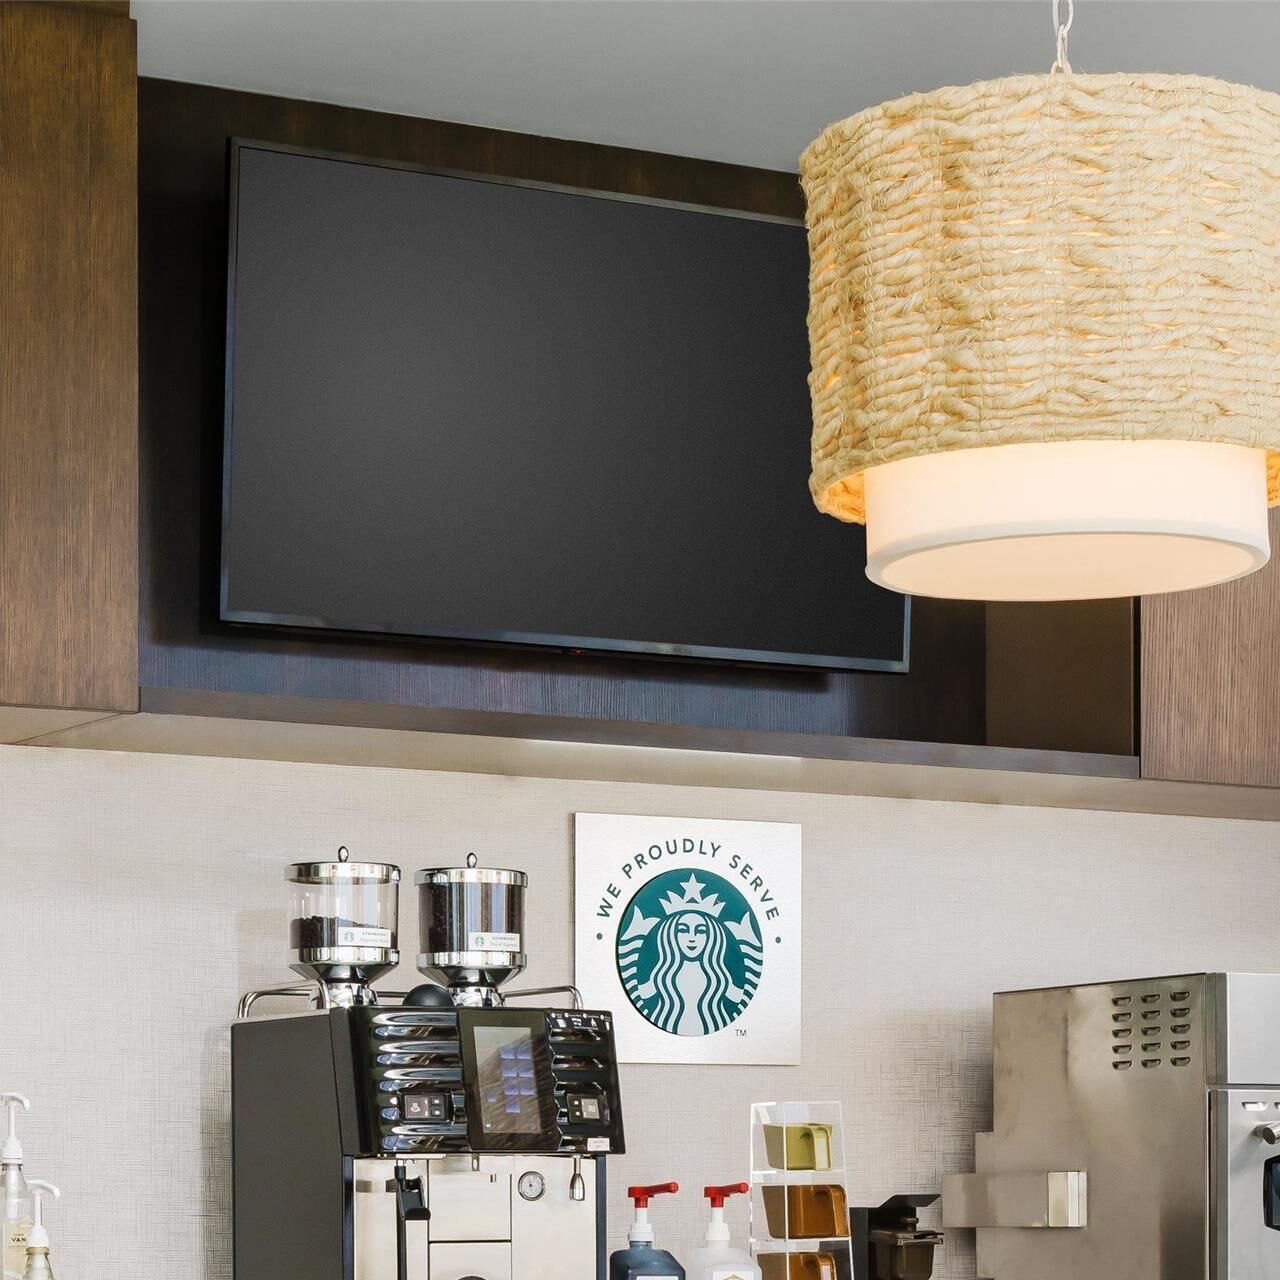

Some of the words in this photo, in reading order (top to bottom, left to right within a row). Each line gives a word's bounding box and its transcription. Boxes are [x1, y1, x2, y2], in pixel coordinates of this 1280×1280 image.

[596, 883, 621, 920] WE
[621, 838, 722, 880] PROUDLY
[728, 854, 780, 921] SERVE
